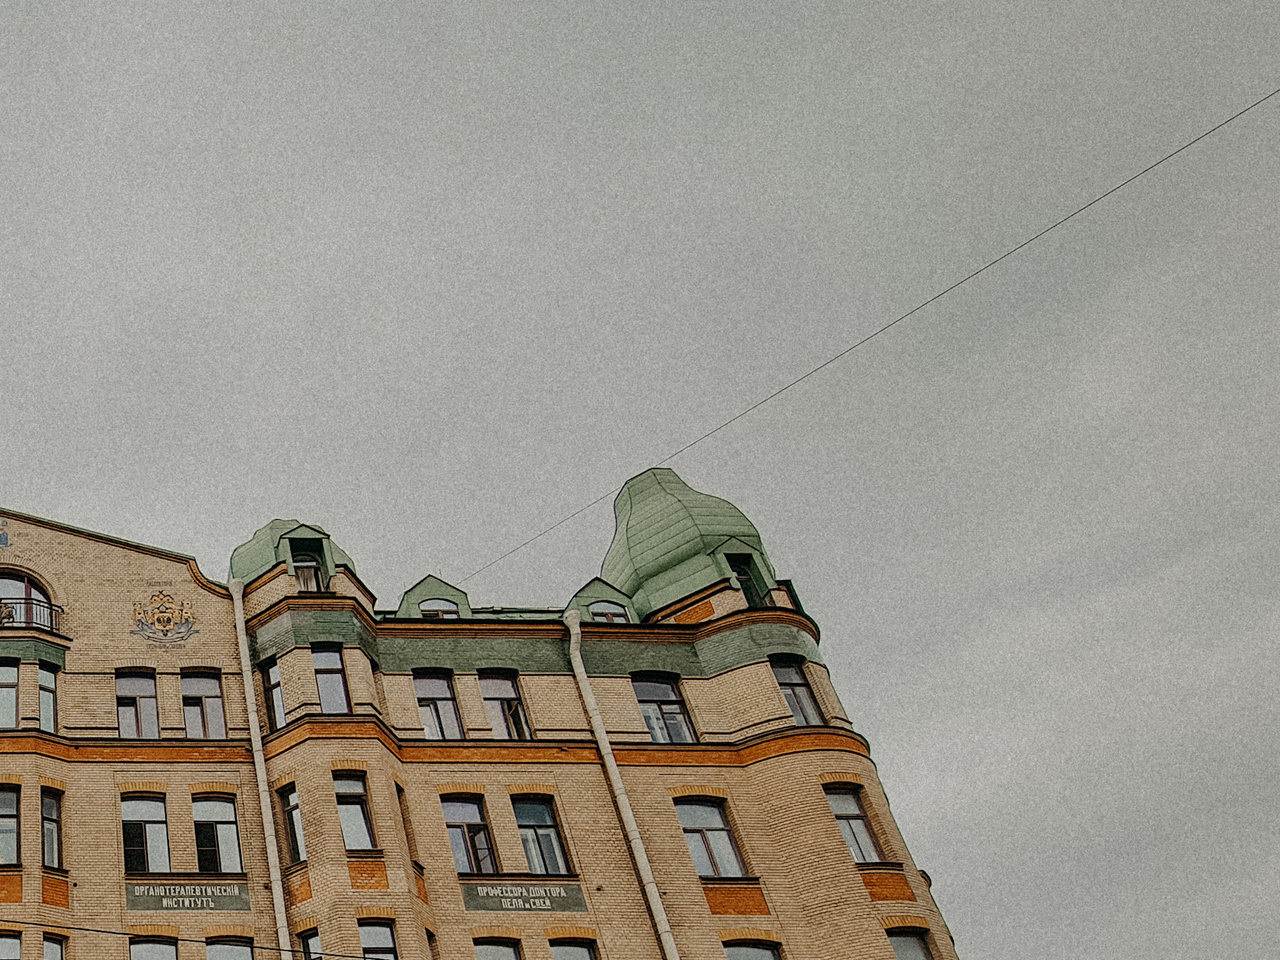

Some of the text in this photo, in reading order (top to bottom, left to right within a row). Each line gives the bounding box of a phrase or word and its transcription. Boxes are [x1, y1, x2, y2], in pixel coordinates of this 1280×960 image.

[477, 886, 567, 898] ПРОФЕССОРА ДОКТОРА
[162, 897, 215, 908] ИНСТИТУТЪ
